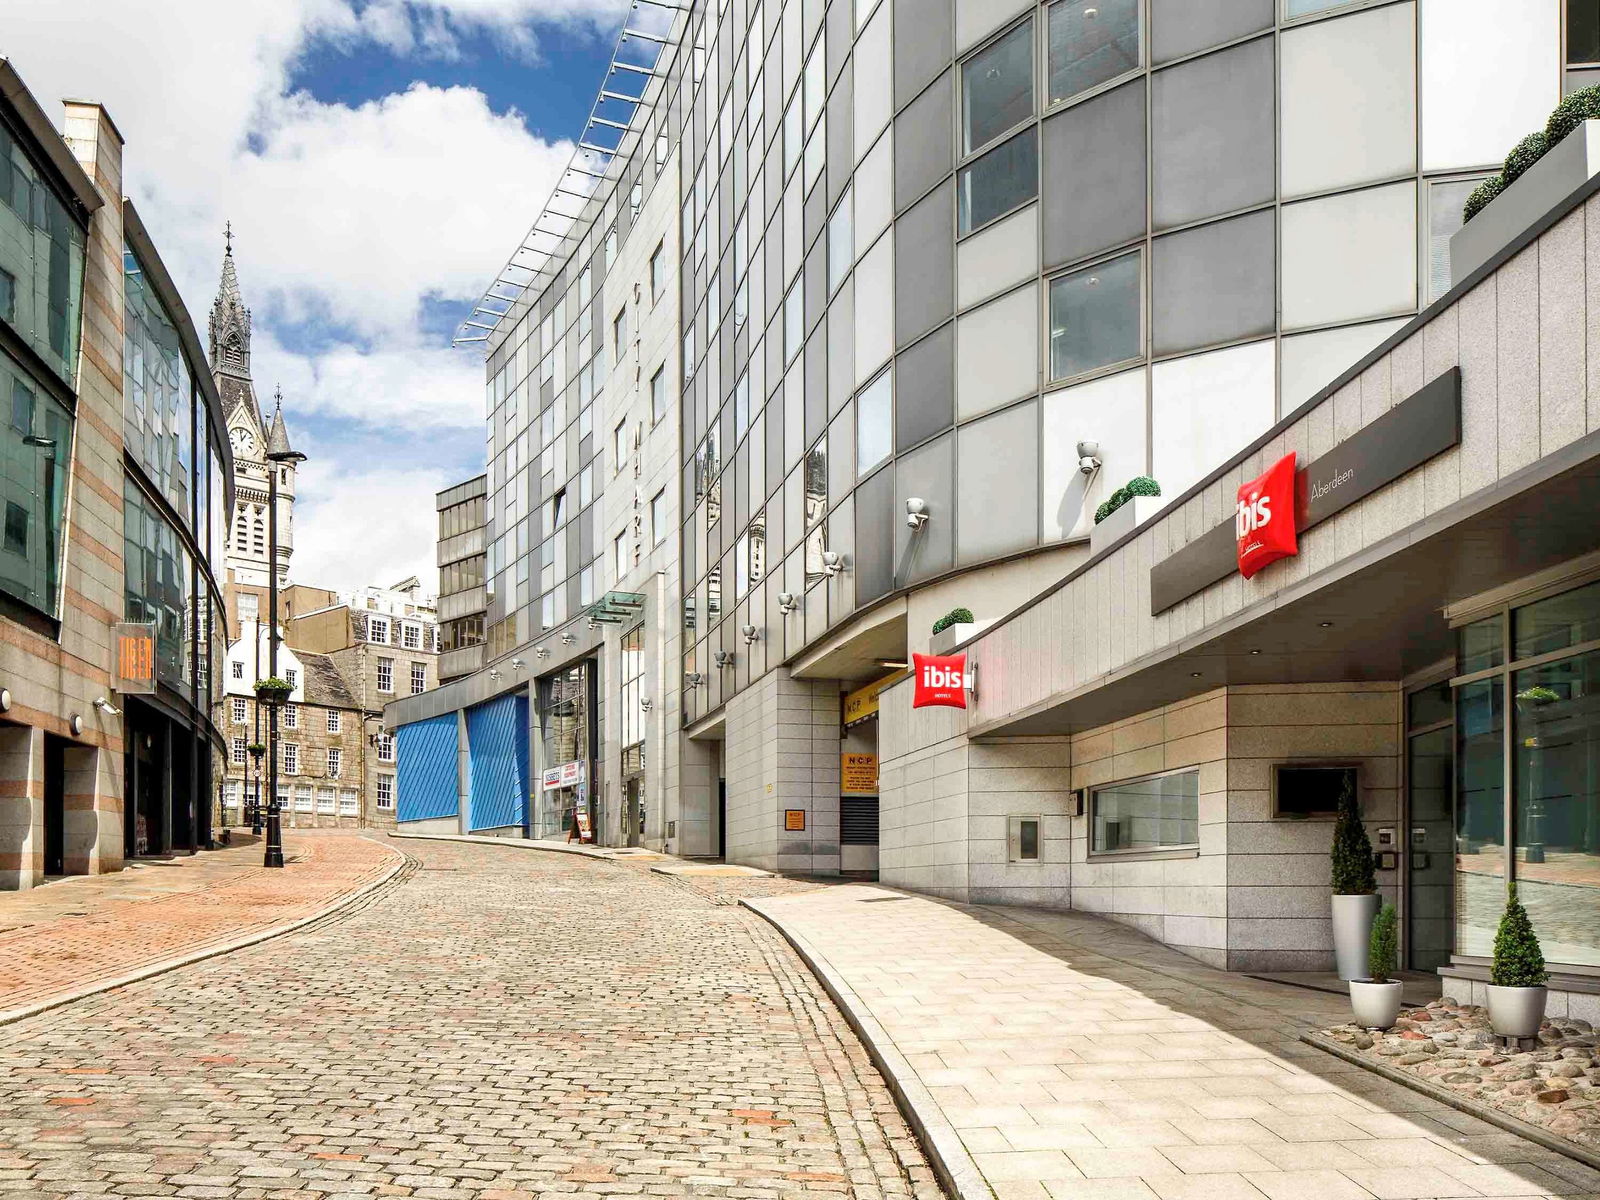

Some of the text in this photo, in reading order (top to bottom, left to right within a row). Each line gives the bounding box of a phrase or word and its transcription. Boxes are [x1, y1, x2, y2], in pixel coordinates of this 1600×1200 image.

[1310, 468, 1354, 502] Aberdeen
[1236, 491, 1271, 541] ibis
[924, 666, 961, 688] ibis
